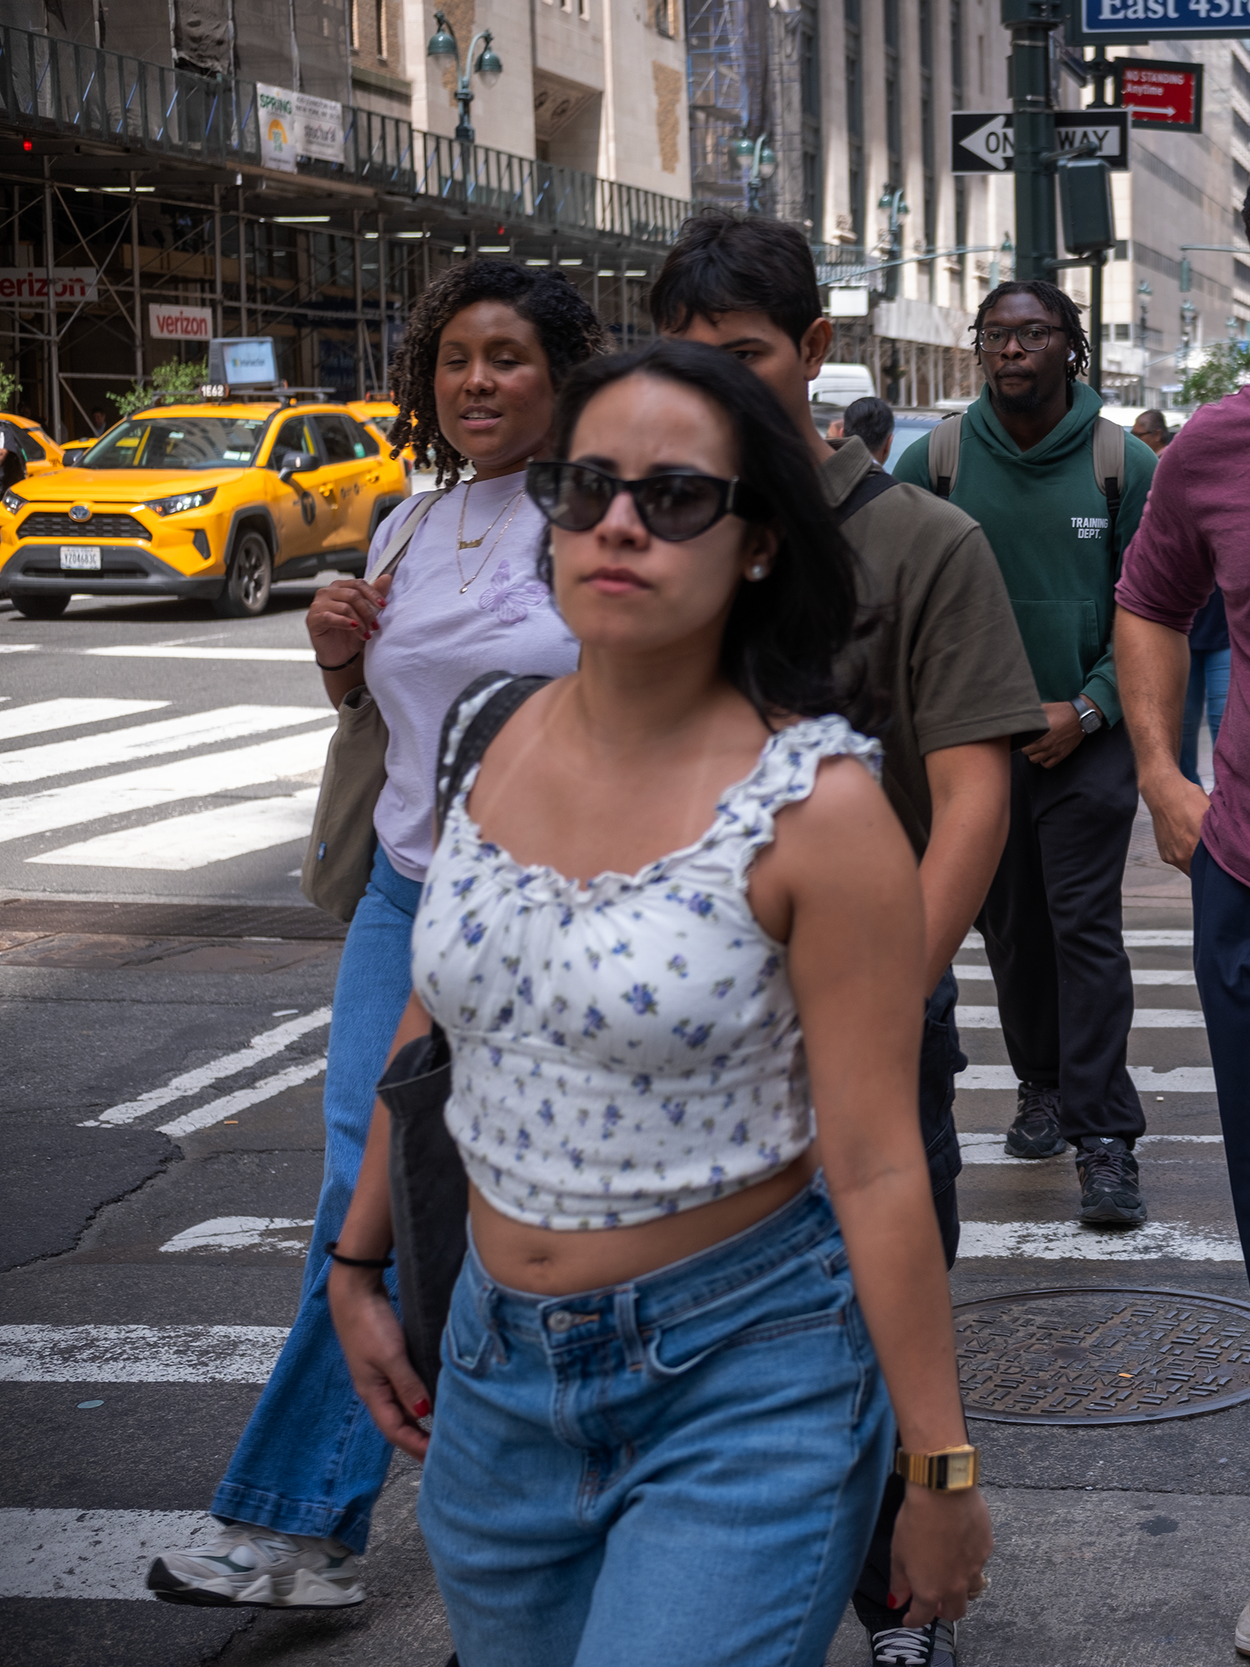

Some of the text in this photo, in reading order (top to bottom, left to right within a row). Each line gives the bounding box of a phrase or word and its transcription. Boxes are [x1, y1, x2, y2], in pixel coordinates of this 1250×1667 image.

[1098, 0, 1180, 20] East
[1125, 69, 1185, 86] NO STANDING
[1126, 83, 1164, 96] Anytime
[1057, 130, 1110, 153] WAY
[0, 272, 86, 297] erizon
[156, 311, 209, 336] verizon
[201, 384, 224, 397] 1E62
[1070, 517, 1109, 529] TRAINING
[1078, 528, 1102, 539] DEPT.
